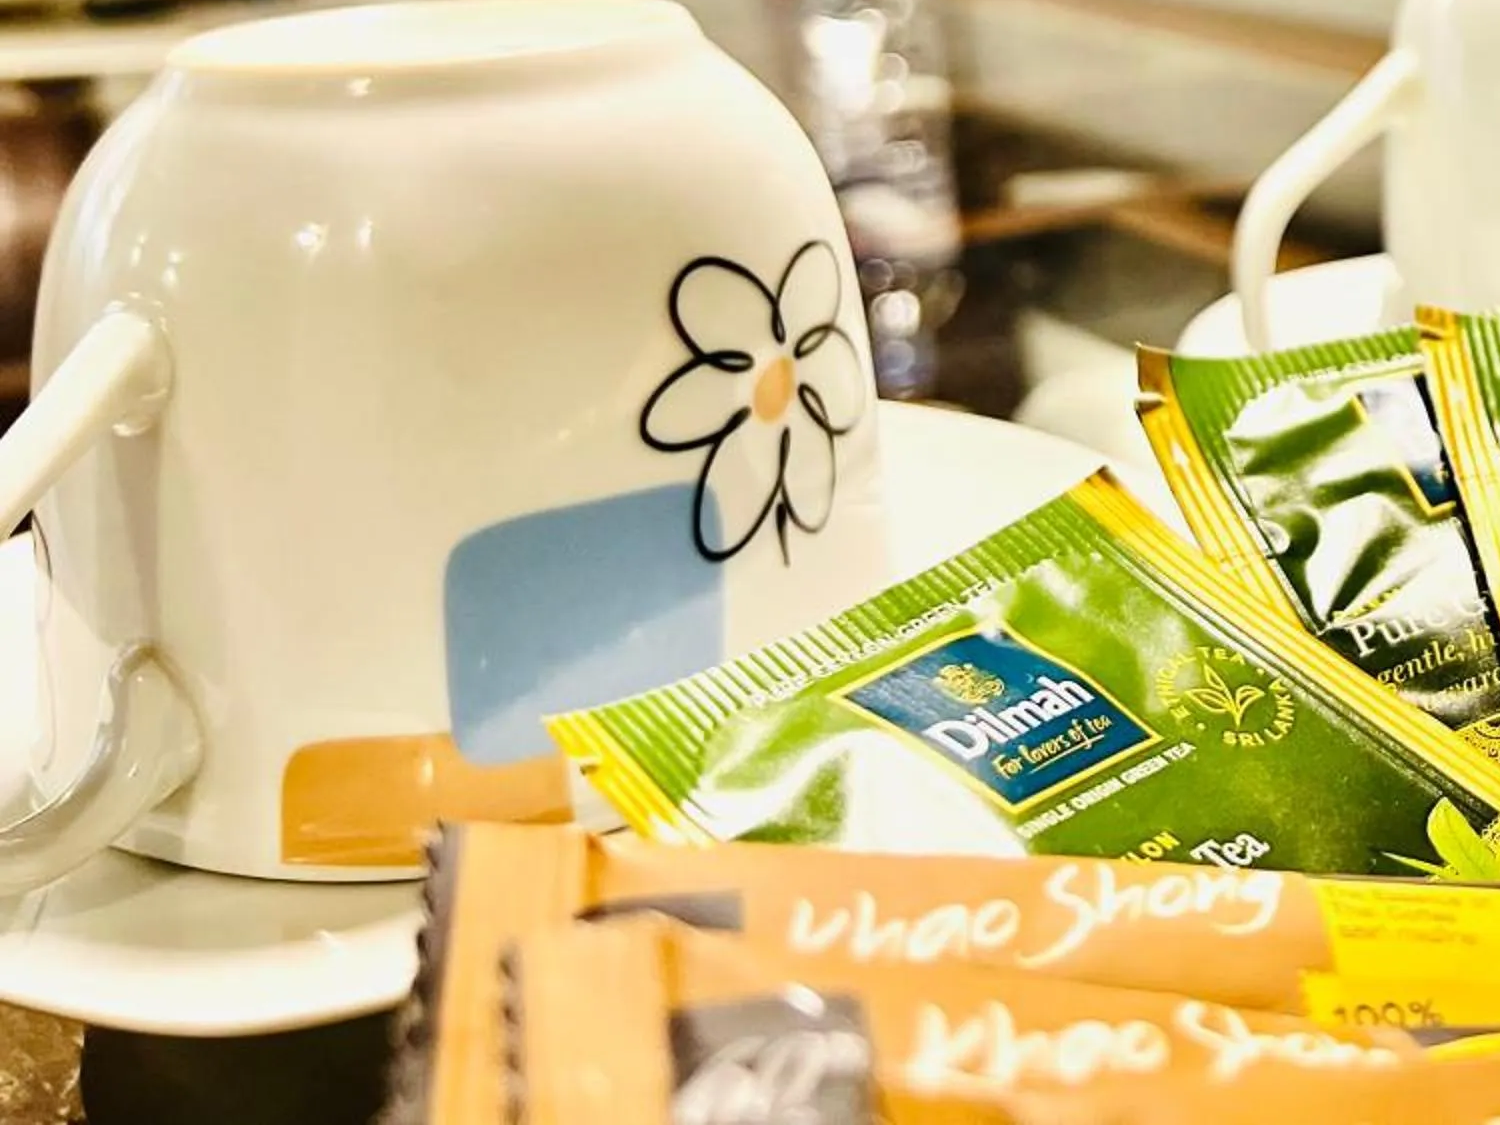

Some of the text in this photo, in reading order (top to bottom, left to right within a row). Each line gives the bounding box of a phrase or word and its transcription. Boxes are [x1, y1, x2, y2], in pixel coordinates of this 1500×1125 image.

[1196, 646, 1245, 665] TEA
[922, 676, 1096, 760] Dilmah
[1222, 729, 1265, 747] SRI
[992, 715, 1113, 779] For lovers of tea
[1189, 833, 1271, 873] Tea
[1016, 862, 1283, 969] Shong
